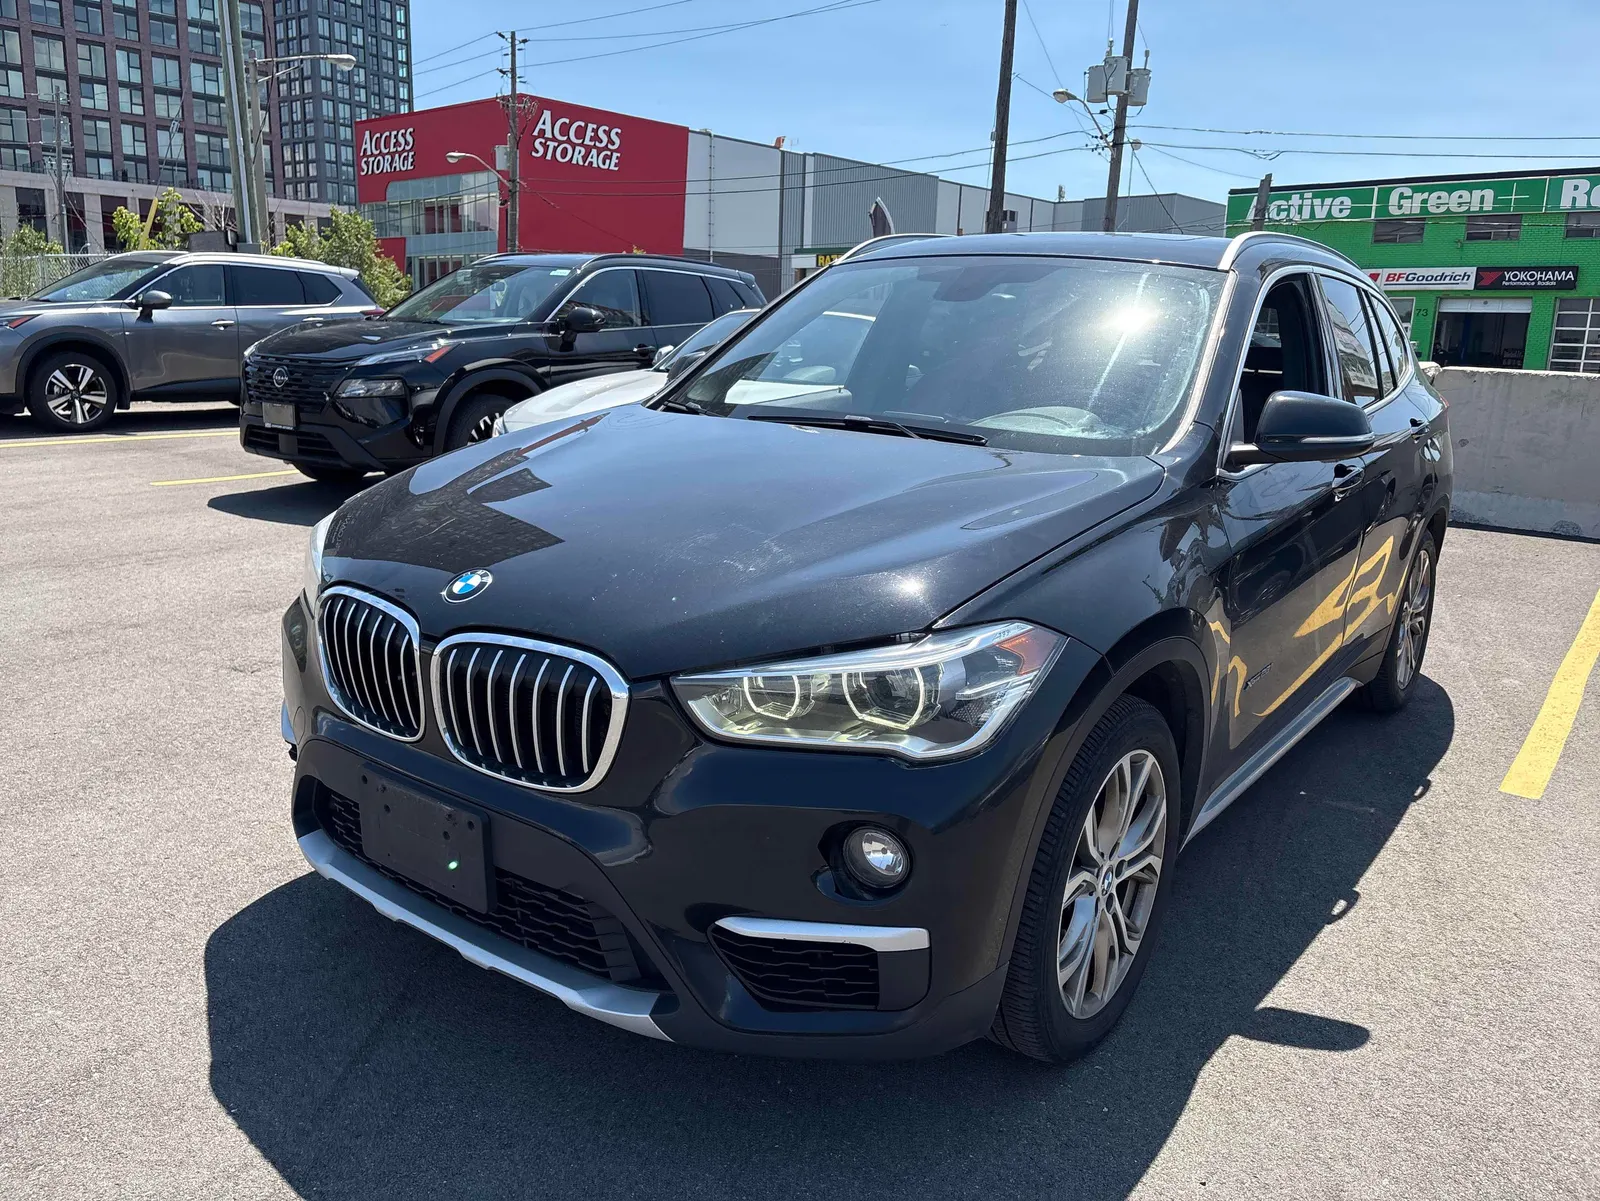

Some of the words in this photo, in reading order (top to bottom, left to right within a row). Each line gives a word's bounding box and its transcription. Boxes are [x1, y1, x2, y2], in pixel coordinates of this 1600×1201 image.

[360, 128, 415, 156] ACCESS
[532, 109, 621, 150] ACCESS
[360, 151, 415, 176] STORAGE
[531, 138, 621, 171] STORAGE
[1388, 186, 1495, 216] Green
[1385, 271, 1471, 282] BFGoodrich
[1504, 270, 1575, 281] YOKOHAMA
[1415, 308, 1429, 317] 73
